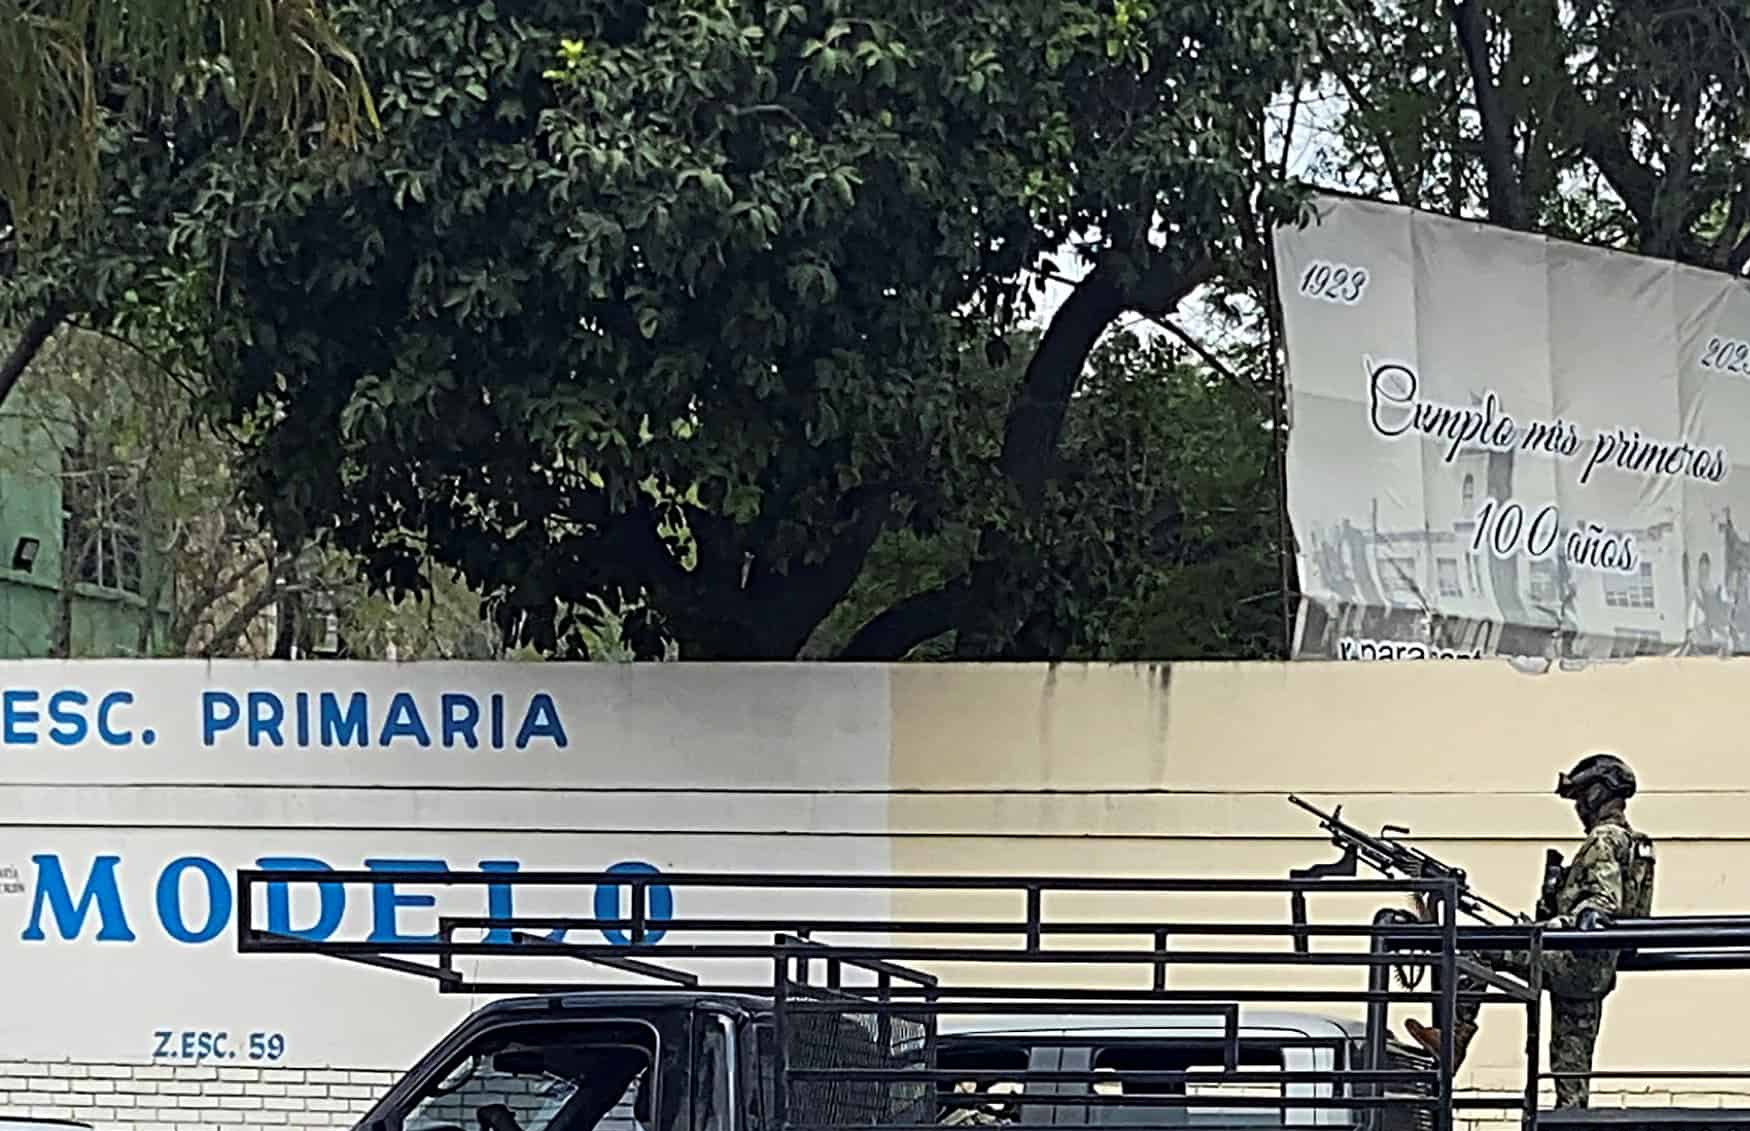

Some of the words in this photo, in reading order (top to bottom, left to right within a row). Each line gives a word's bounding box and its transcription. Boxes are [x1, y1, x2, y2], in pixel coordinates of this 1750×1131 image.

[1301, 263, 1366, 301] 1923
[1521, 419, 1583, 456] mis
[1473, 503, 1559, 556] 100
[1567, 524, 1638, 571] años
[2, 690, 156, 746] ESC.
[201, 691, 569, 749] PRIMARIA
[20, 854, 674, 946] MODELO
[152, 1031, 236, 1059] Z.ESC.
[248, 1032, 286, 1060] 59
